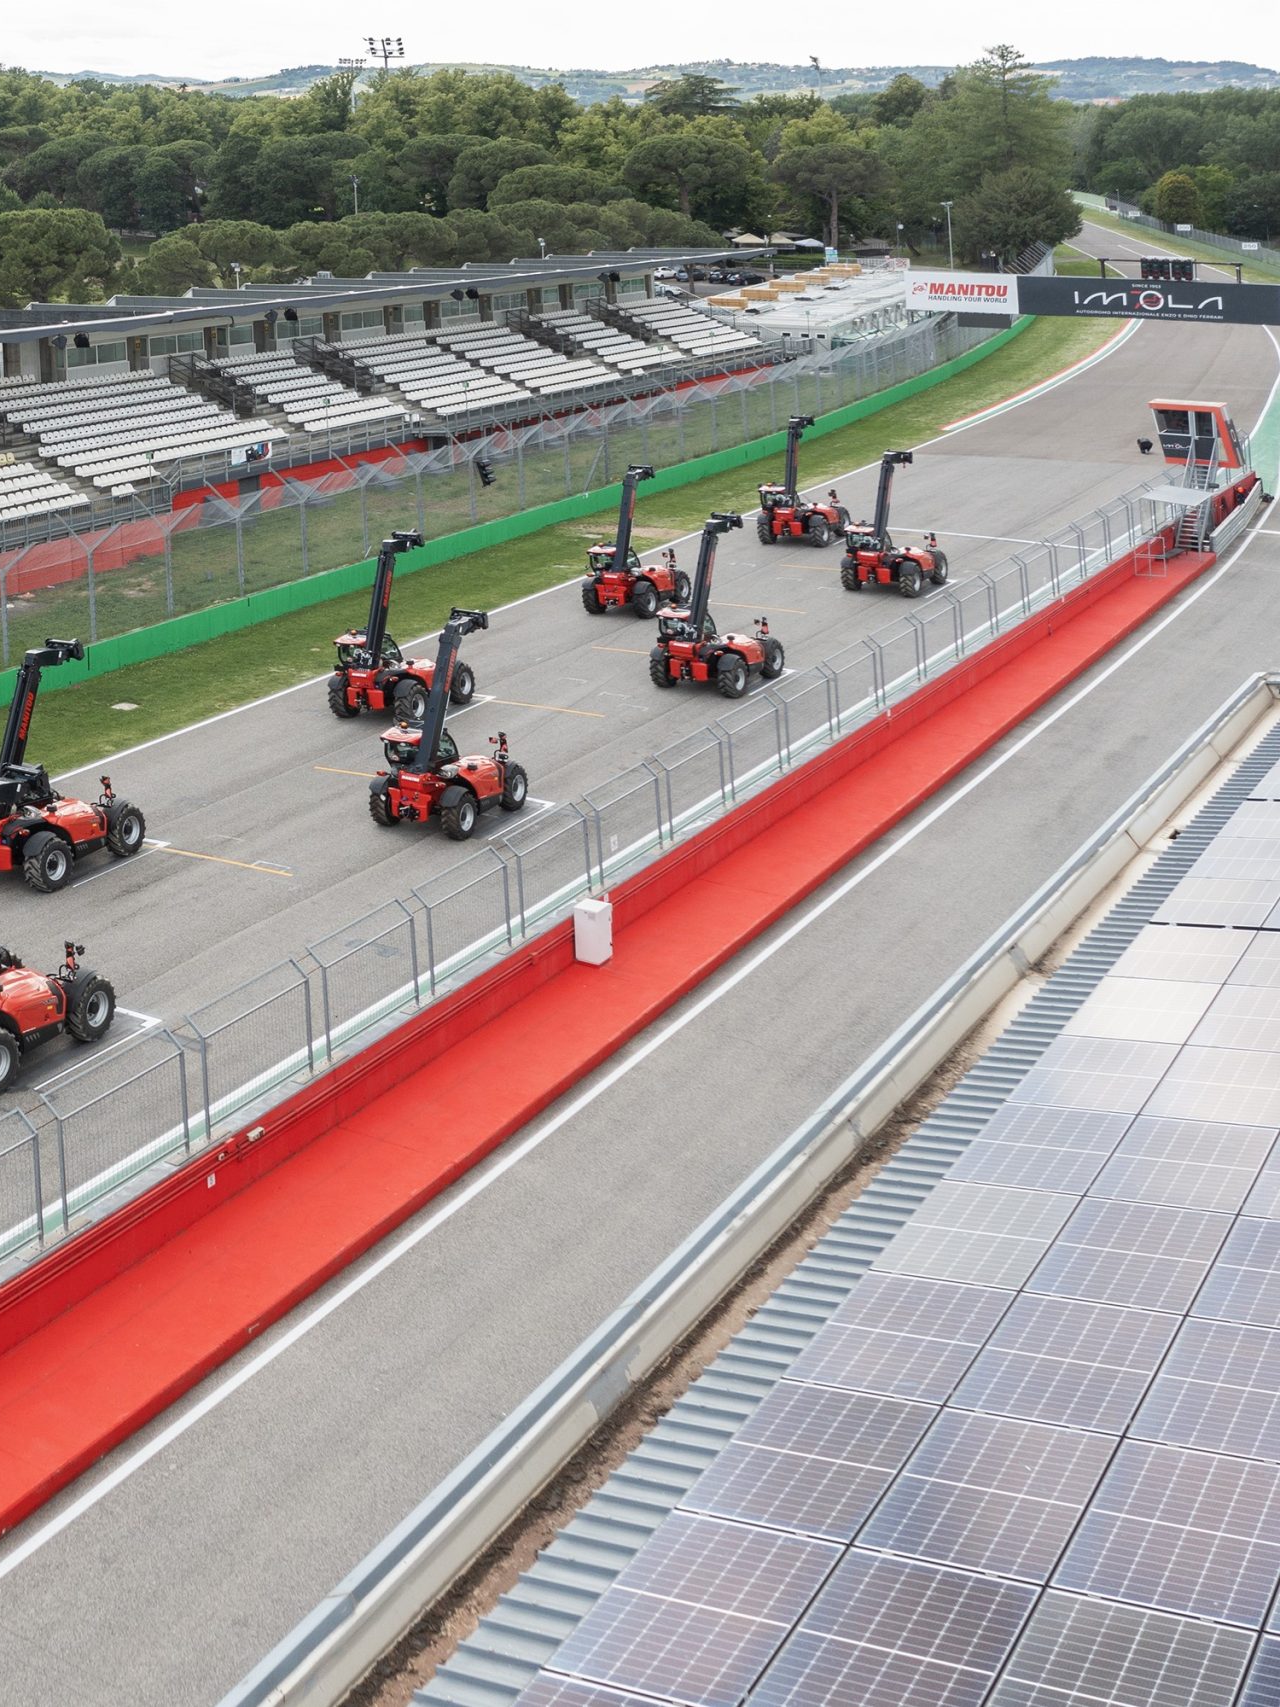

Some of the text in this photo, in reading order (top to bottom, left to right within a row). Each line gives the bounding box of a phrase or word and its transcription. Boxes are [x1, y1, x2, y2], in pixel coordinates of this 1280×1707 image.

[929, 283, 1008, 297] MANITOU
[1074, 290, 1223, 310] IMOLA
[18, 691, 34, 740] MANITOU
